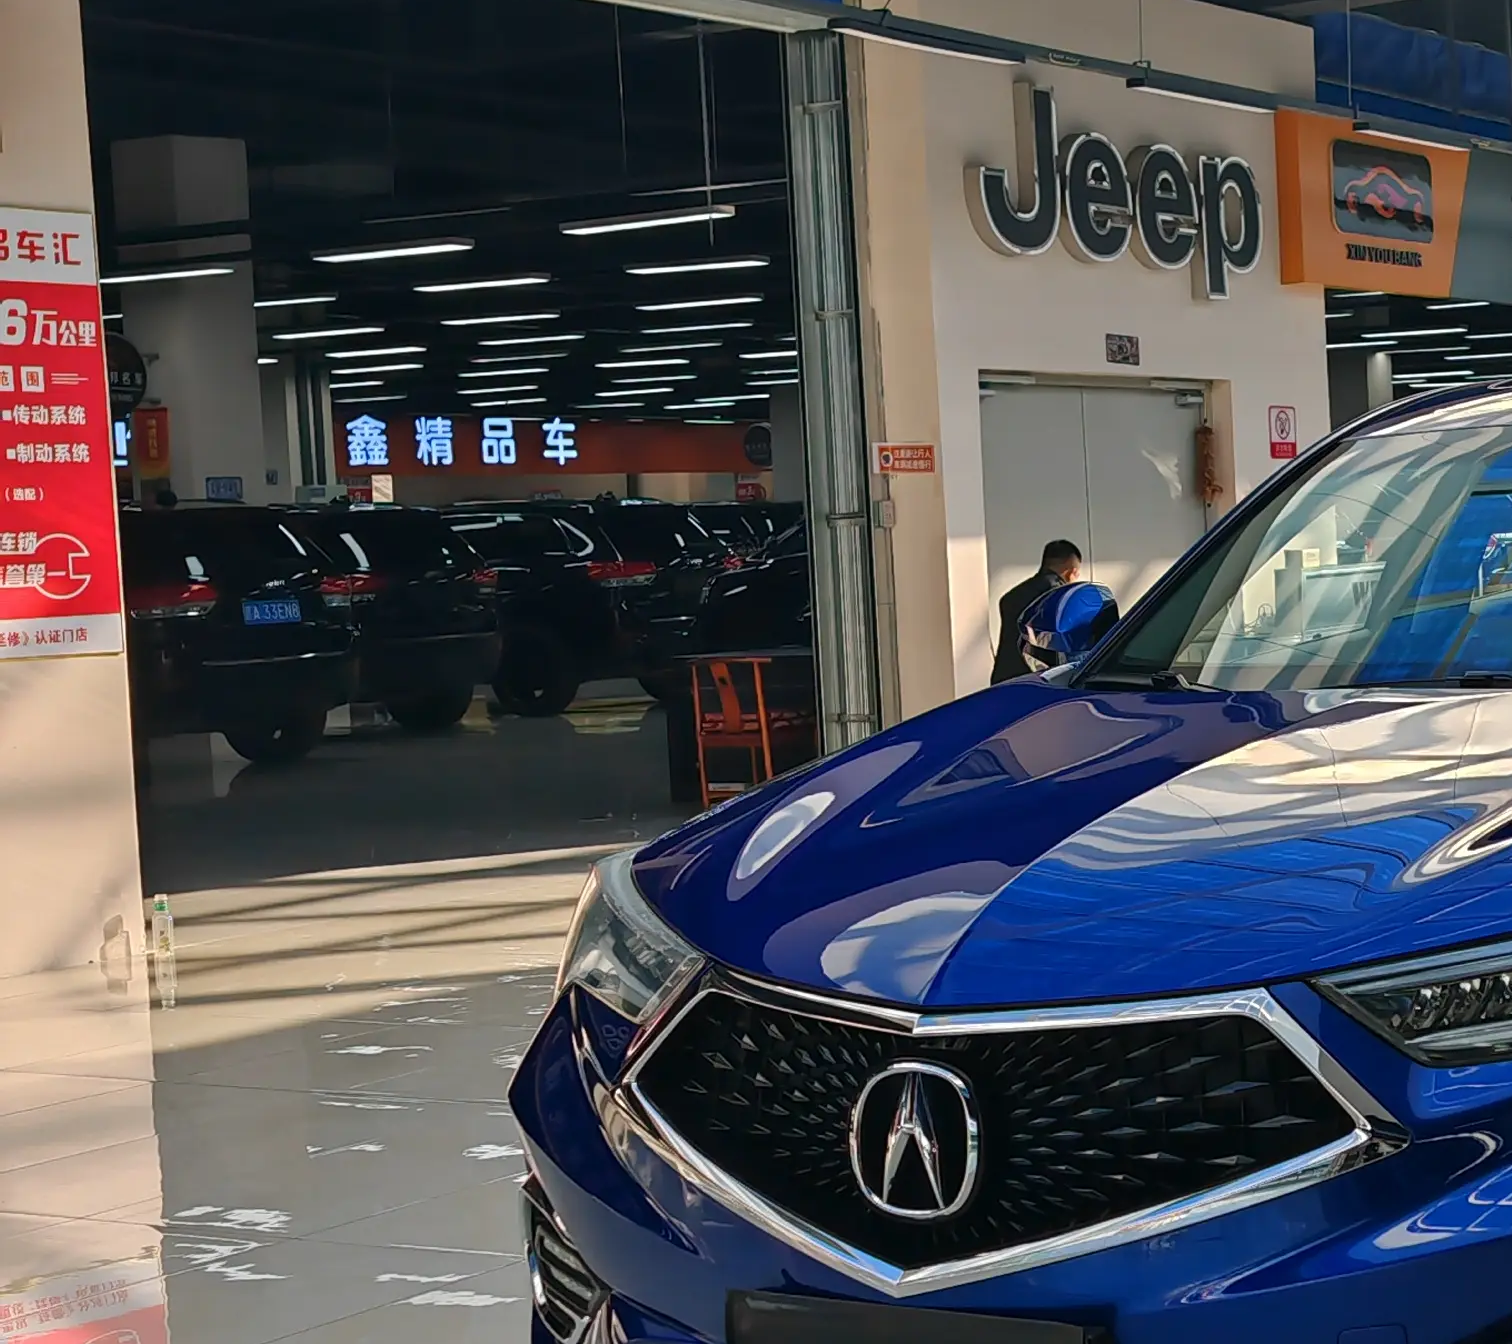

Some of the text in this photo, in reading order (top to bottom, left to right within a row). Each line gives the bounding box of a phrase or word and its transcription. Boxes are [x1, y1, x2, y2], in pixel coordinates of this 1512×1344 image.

[964, 81, 1264, 302] Jeep
[0, 298, 97, 348] 6万公里
[13, 404, 87, 426] 传动系统
[16, 442, 90, 464] 制动系统
[346, 414, 579, 466] 鑫精品车
[0, 563, 67, 587] 誉第一
